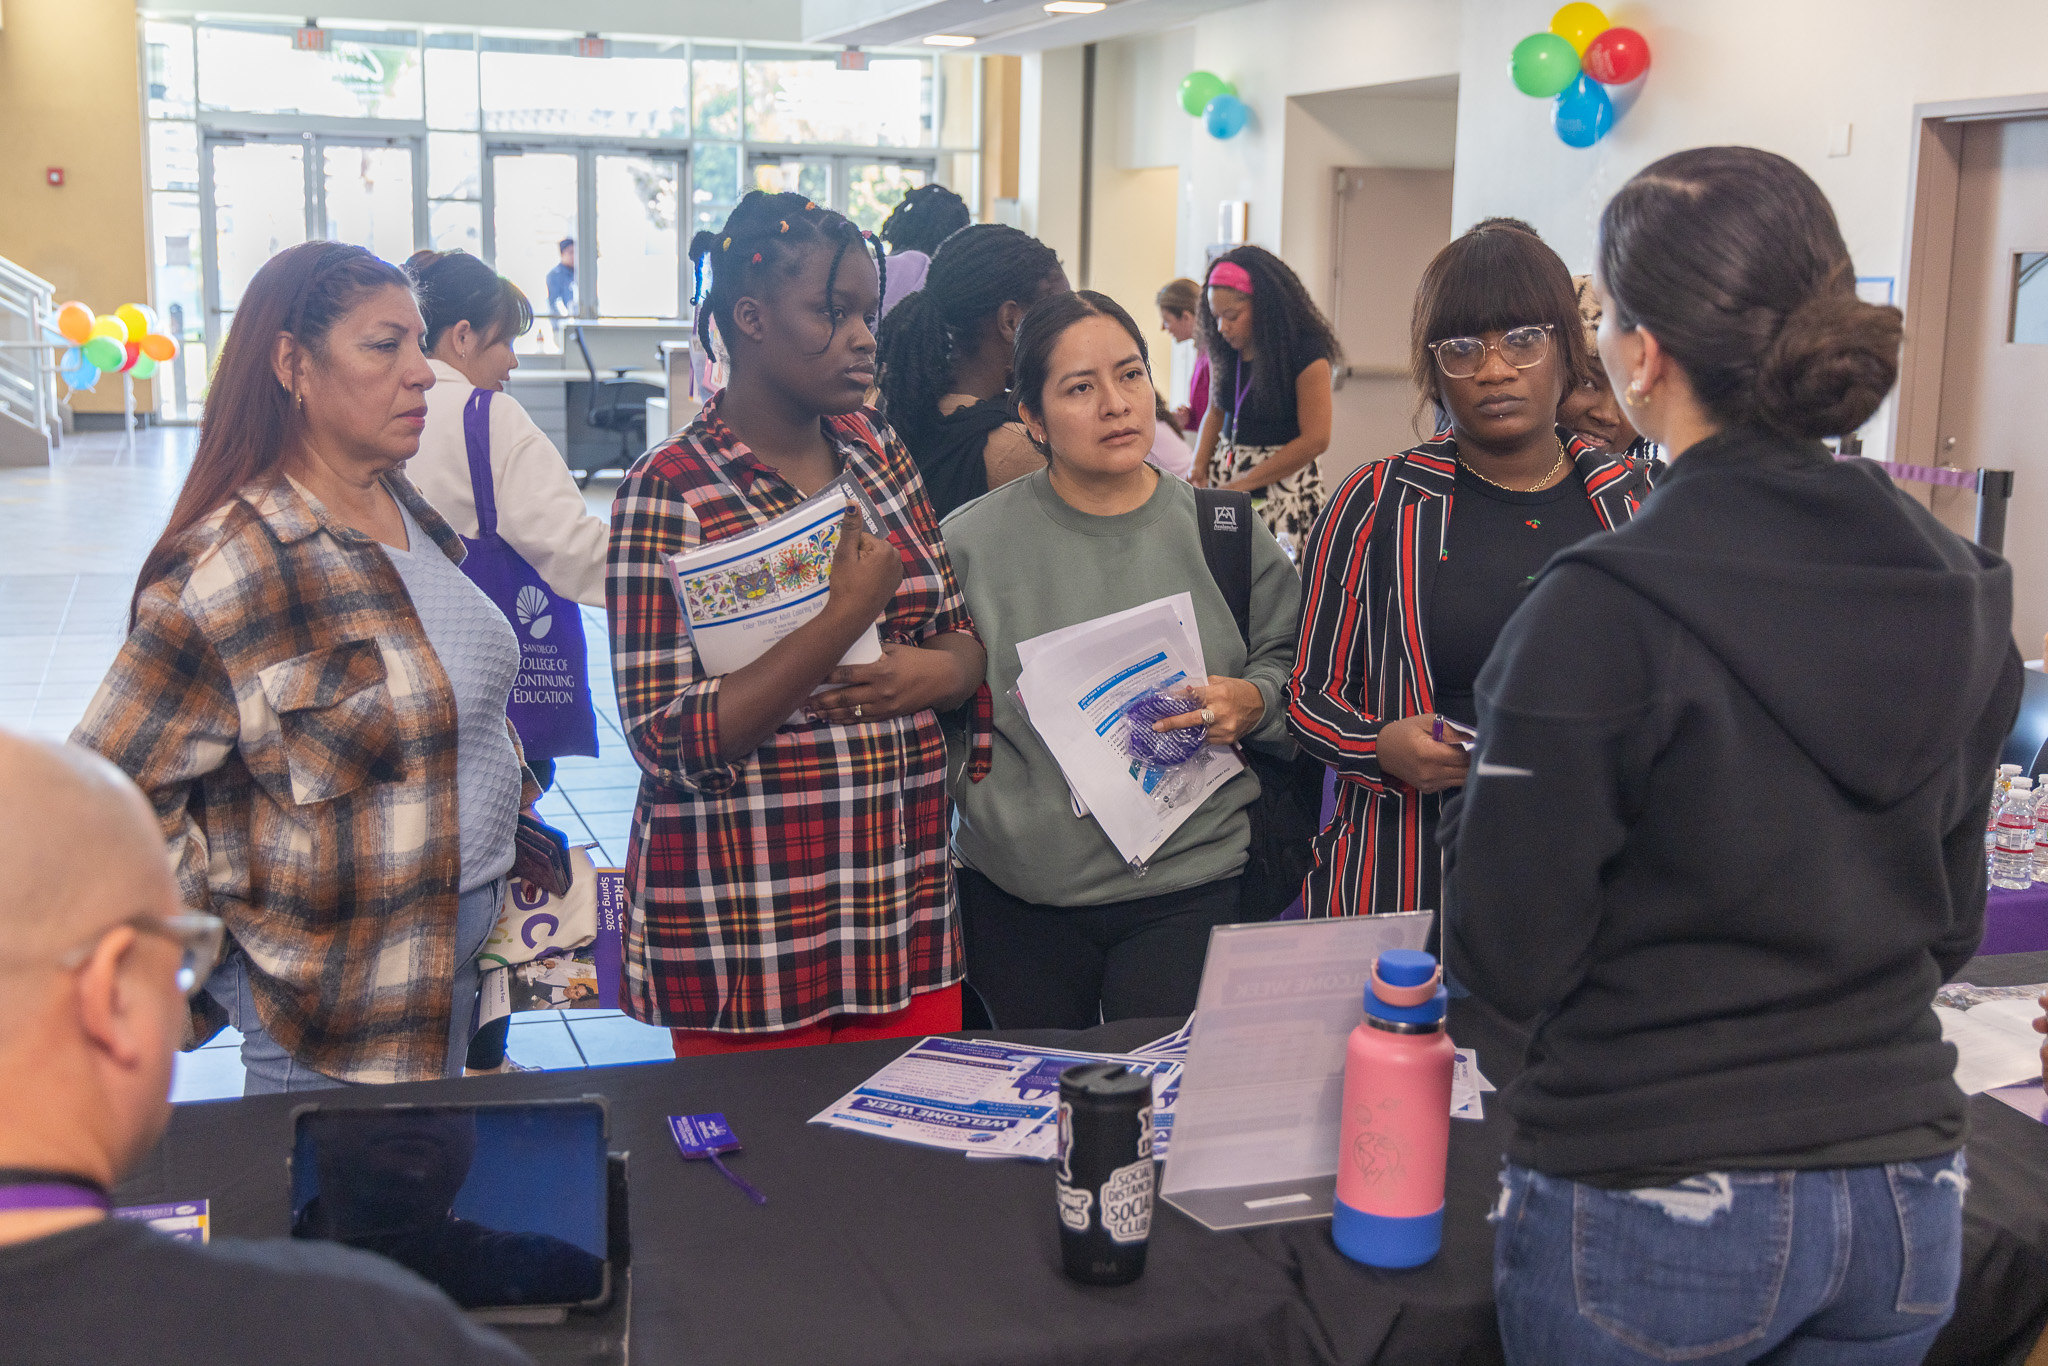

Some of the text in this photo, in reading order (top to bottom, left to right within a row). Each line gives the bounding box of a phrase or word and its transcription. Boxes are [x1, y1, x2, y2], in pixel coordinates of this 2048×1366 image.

[297, 29, 324, 49] EXIT
[522, 643, 558, 655] SAN DIEGO
[556, 658, 568, 671] OF
[513, 688, 573, 704] EDUCATION
[613, 877, 625, 910] FREE
[600, 876, 615, 931] Spring 2026
[862, 1098, 916, 1117] WEEK
[916, 1109, 1010, 1129] WELCOME
[923, 1117, 958, 1128] SPRING
